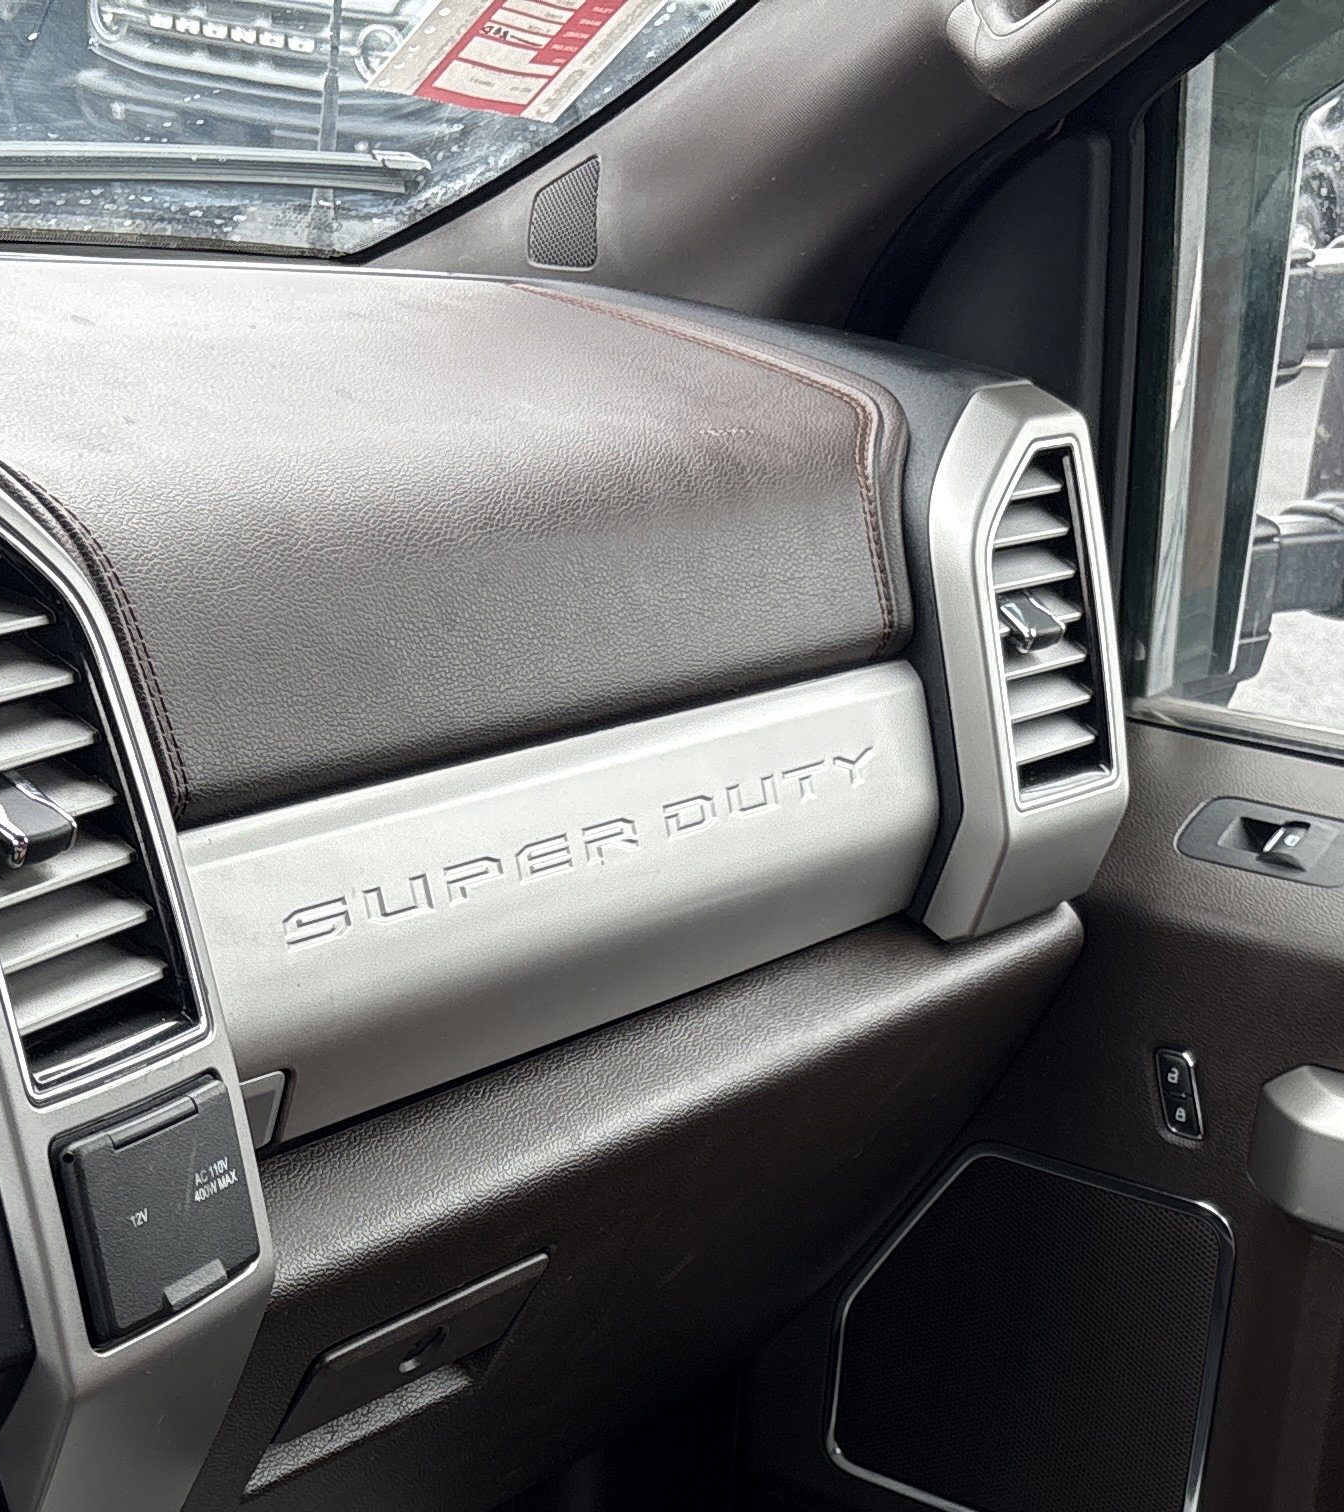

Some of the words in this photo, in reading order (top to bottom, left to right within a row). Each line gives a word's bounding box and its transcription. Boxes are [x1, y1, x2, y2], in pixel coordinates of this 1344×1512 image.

[281, 816, 640, 953] SUPER
[661, 746, 875, 841] DUTY
[194, 1180, 217, 1202] 400W
[217, 1169, 238, 1190] MAX
[195, 1170, 208, 1186] AC
[208, 1156, 228, 1178] 110V
[130, 1208, 148, 1228] 12V
